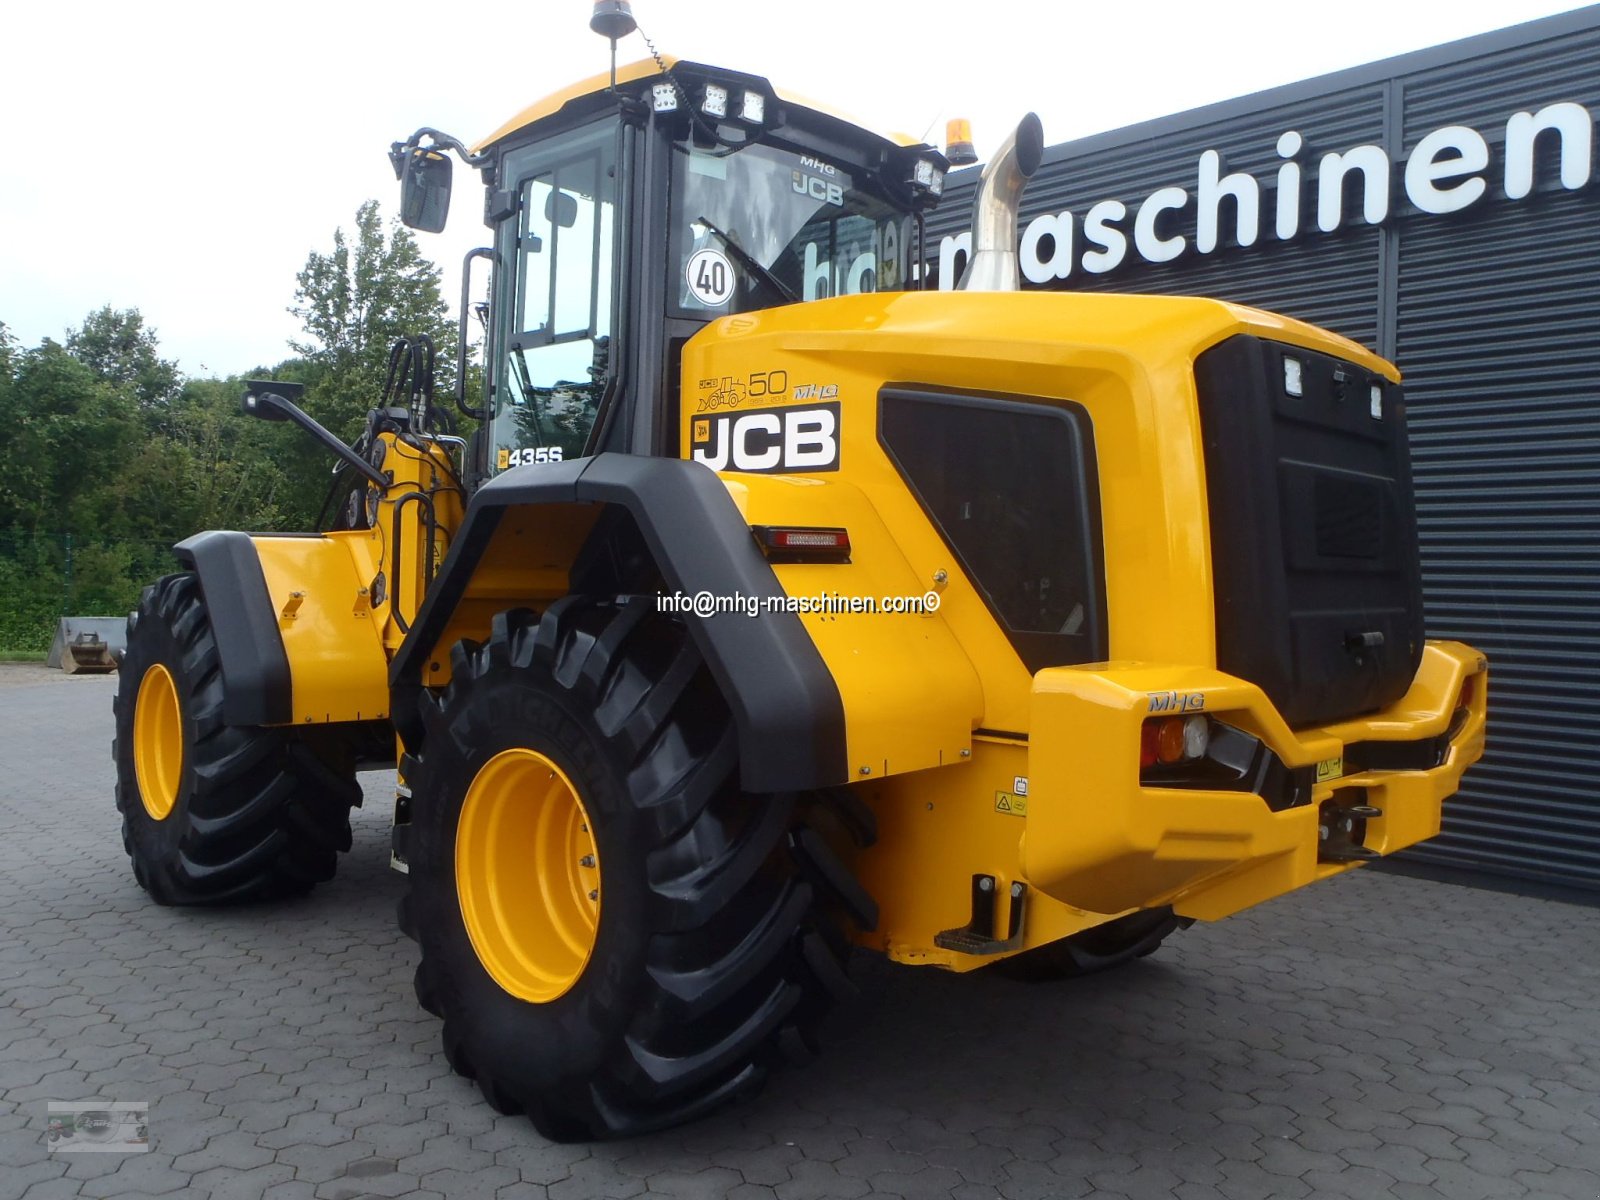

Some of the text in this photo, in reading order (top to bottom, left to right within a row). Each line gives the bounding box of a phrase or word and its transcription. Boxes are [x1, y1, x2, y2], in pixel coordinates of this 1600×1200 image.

[800, 156, 836, 177] MHG
[792, 173, 844, 207] JCB
[696, 259, 725, 296] 40
[699, 370, 788, 397] JCB 50
[794, 383, 838, 400] MHG
[693, 409, 836, 472] JCB
[508, 446, 563, 467] 435S
[1147, 691, 1205, 713] MHG
